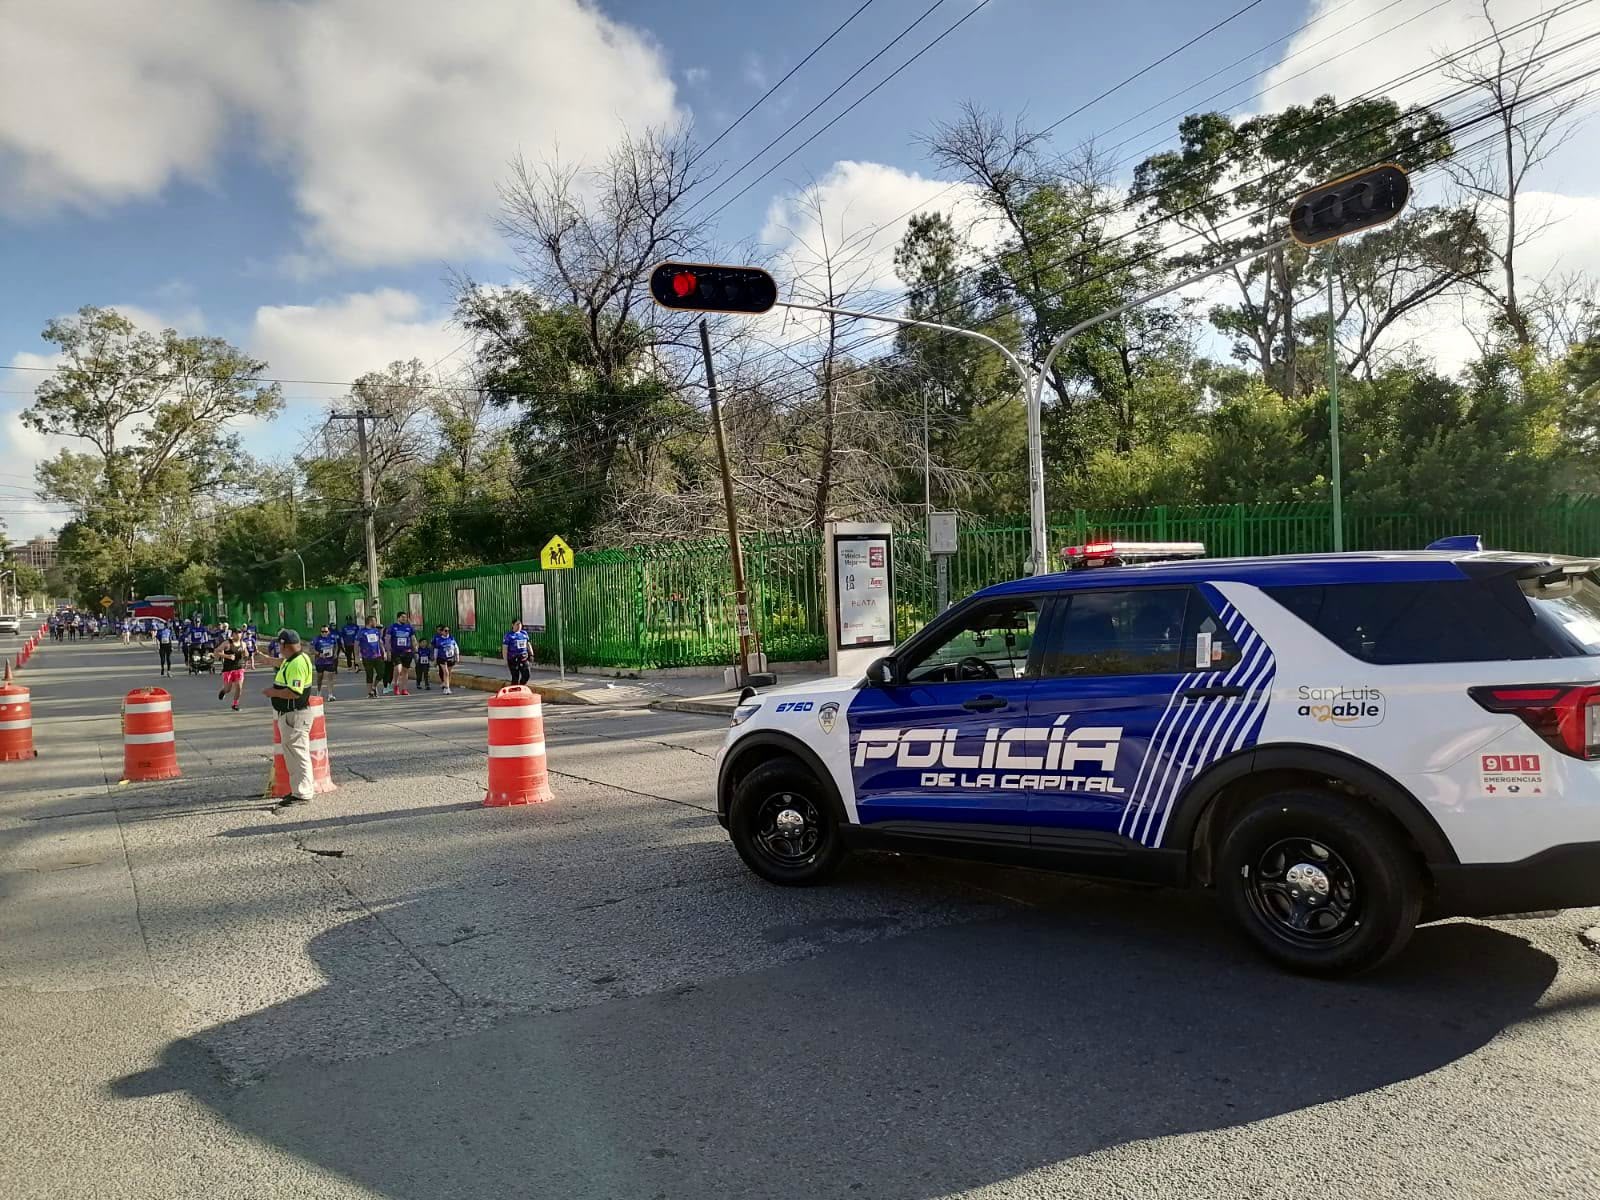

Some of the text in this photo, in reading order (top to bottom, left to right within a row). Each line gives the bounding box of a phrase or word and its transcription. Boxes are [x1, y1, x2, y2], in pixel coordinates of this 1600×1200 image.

[1298, 684, 1380, 700] San Luis
[775, 700, 814, 713] 6760
[1298, 701, 1380, 721] amable
[853, 714, 1124, 772] POLICÍA
[1483, 756, 1540, 770] 911
[921, 772, 1125, 793] DE LA CAPITAL
